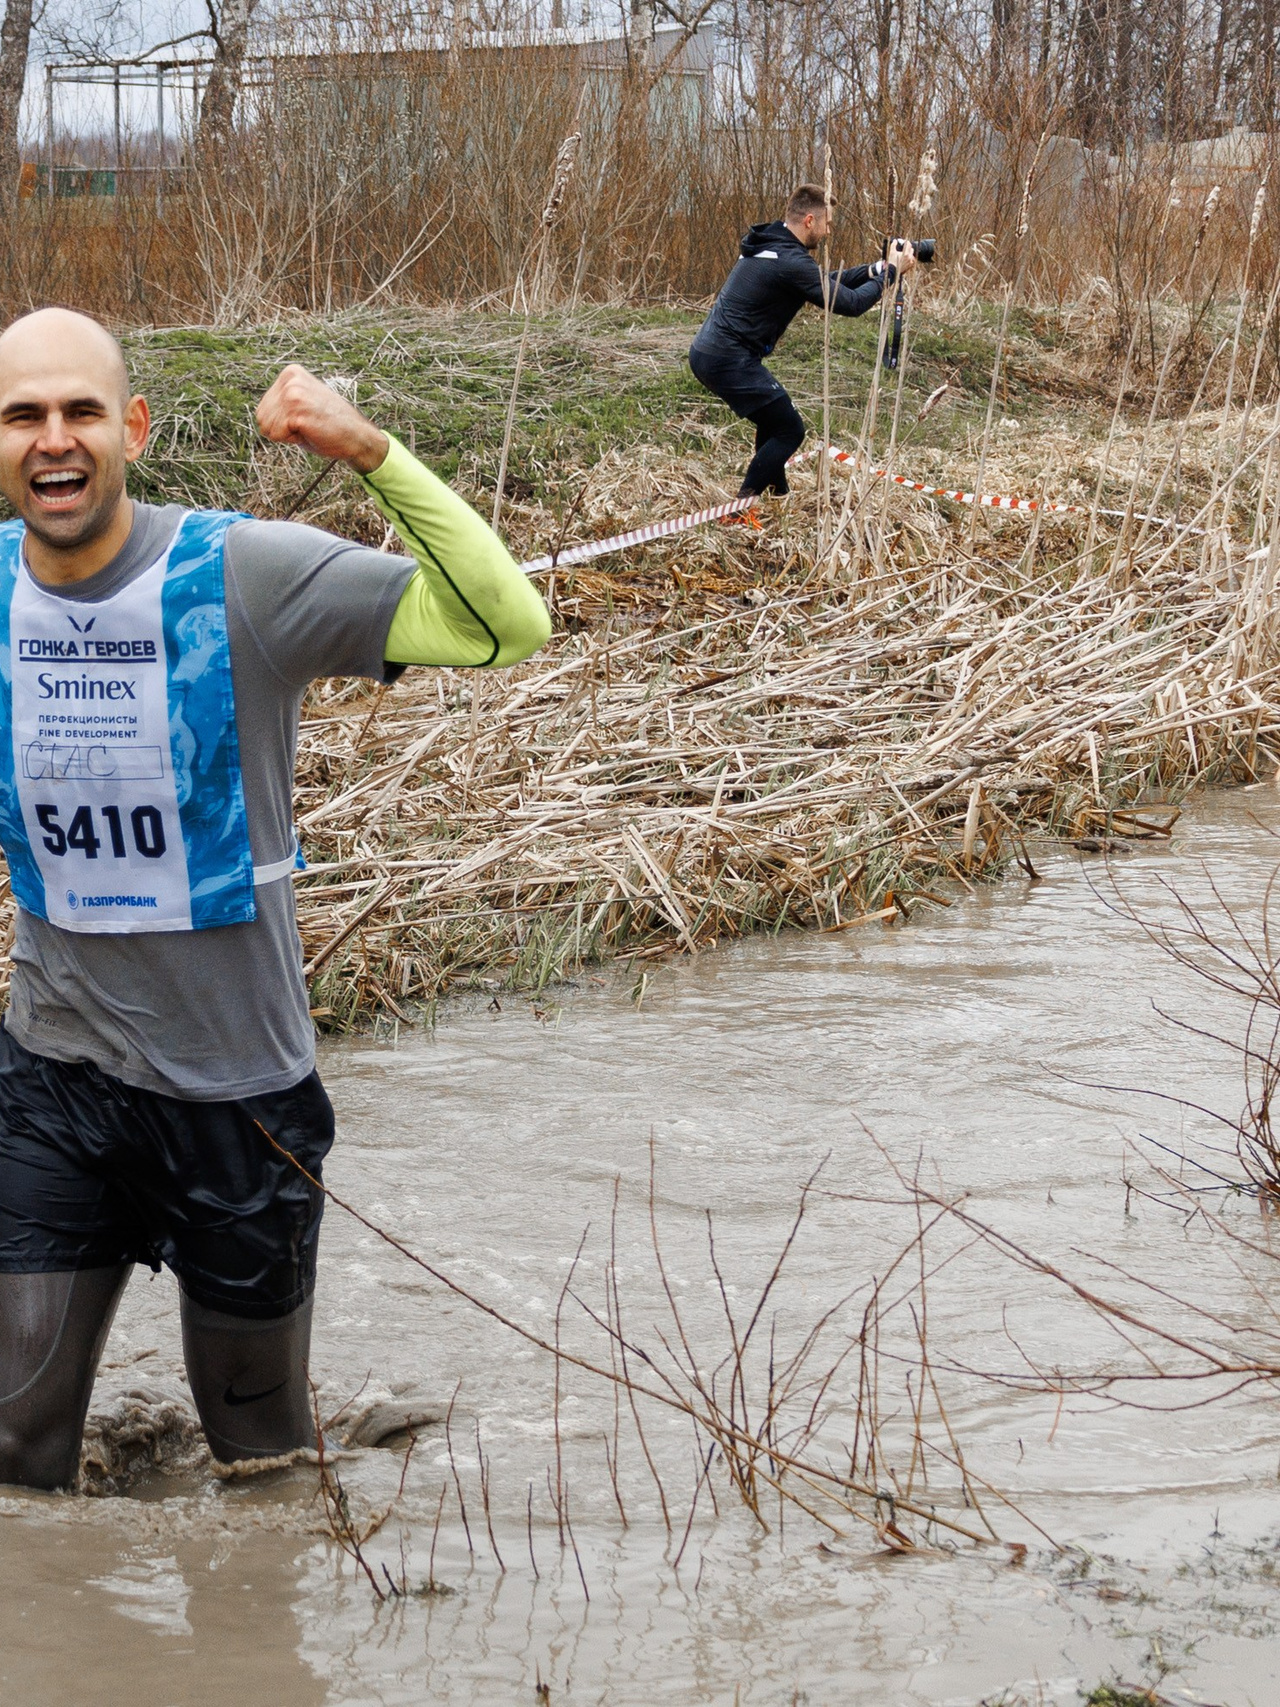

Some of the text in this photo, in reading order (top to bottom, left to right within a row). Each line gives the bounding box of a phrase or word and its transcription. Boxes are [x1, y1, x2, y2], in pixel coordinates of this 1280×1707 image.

[18, 639, 156, 657] ГОНКА ГЕРОЕВ
[37, 673, 136, 700] Sminex
[38, 714, 138, 725] ПЕРФЕКЦИОНИСТЫ
[38, 729, 138, 739] FINE DEVELOPMENT
[35, 804, 167, 859] 5410
[81, 895, 158, 908] ГАЗПРОМБАНК
